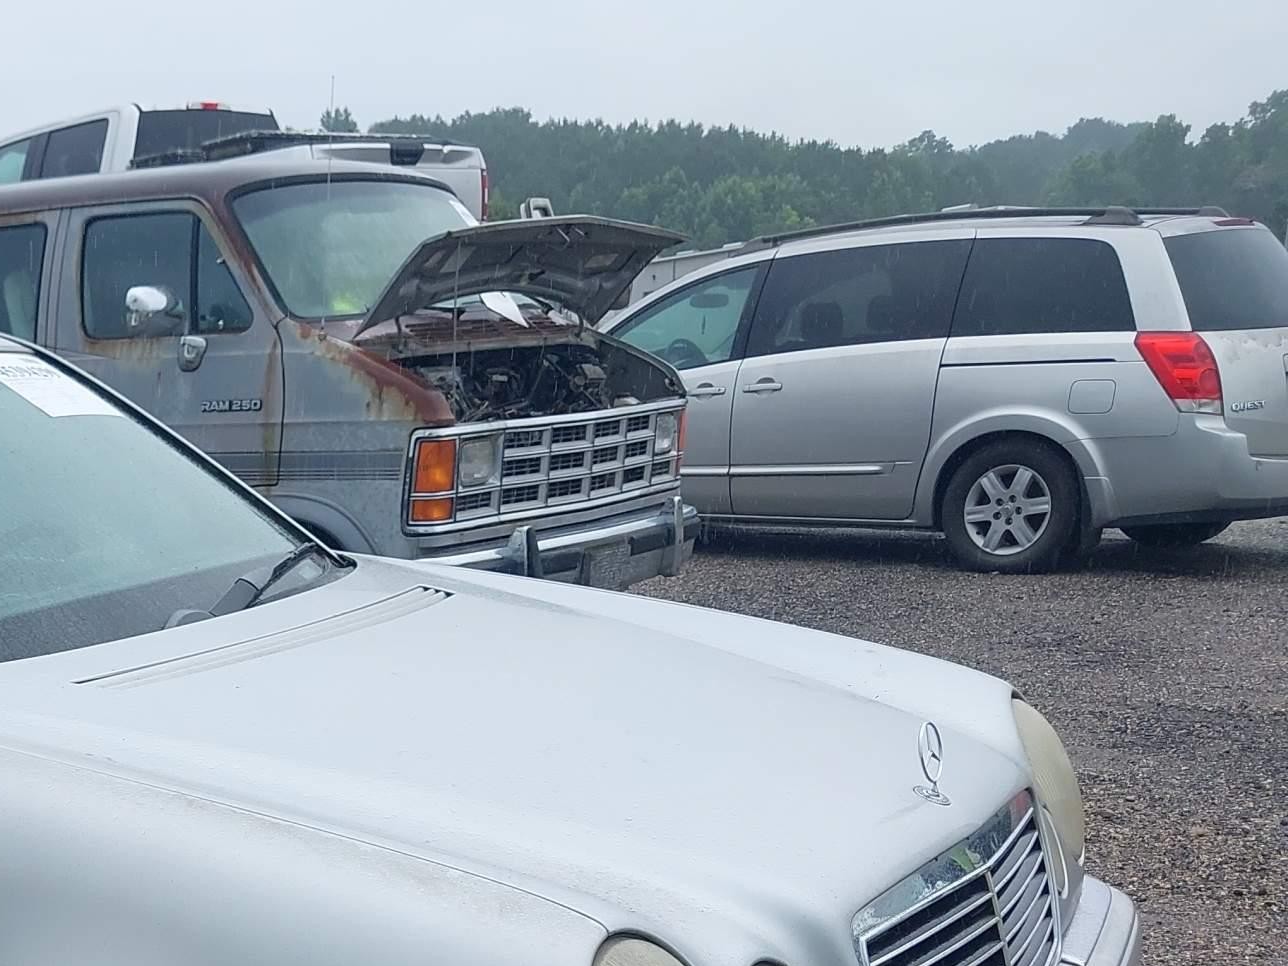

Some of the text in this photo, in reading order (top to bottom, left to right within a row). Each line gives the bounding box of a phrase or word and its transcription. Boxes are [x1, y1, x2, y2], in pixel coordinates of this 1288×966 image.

[201, 399, 262, 412] RAM 250
[1231, 400, 1265, 412] QUEST
